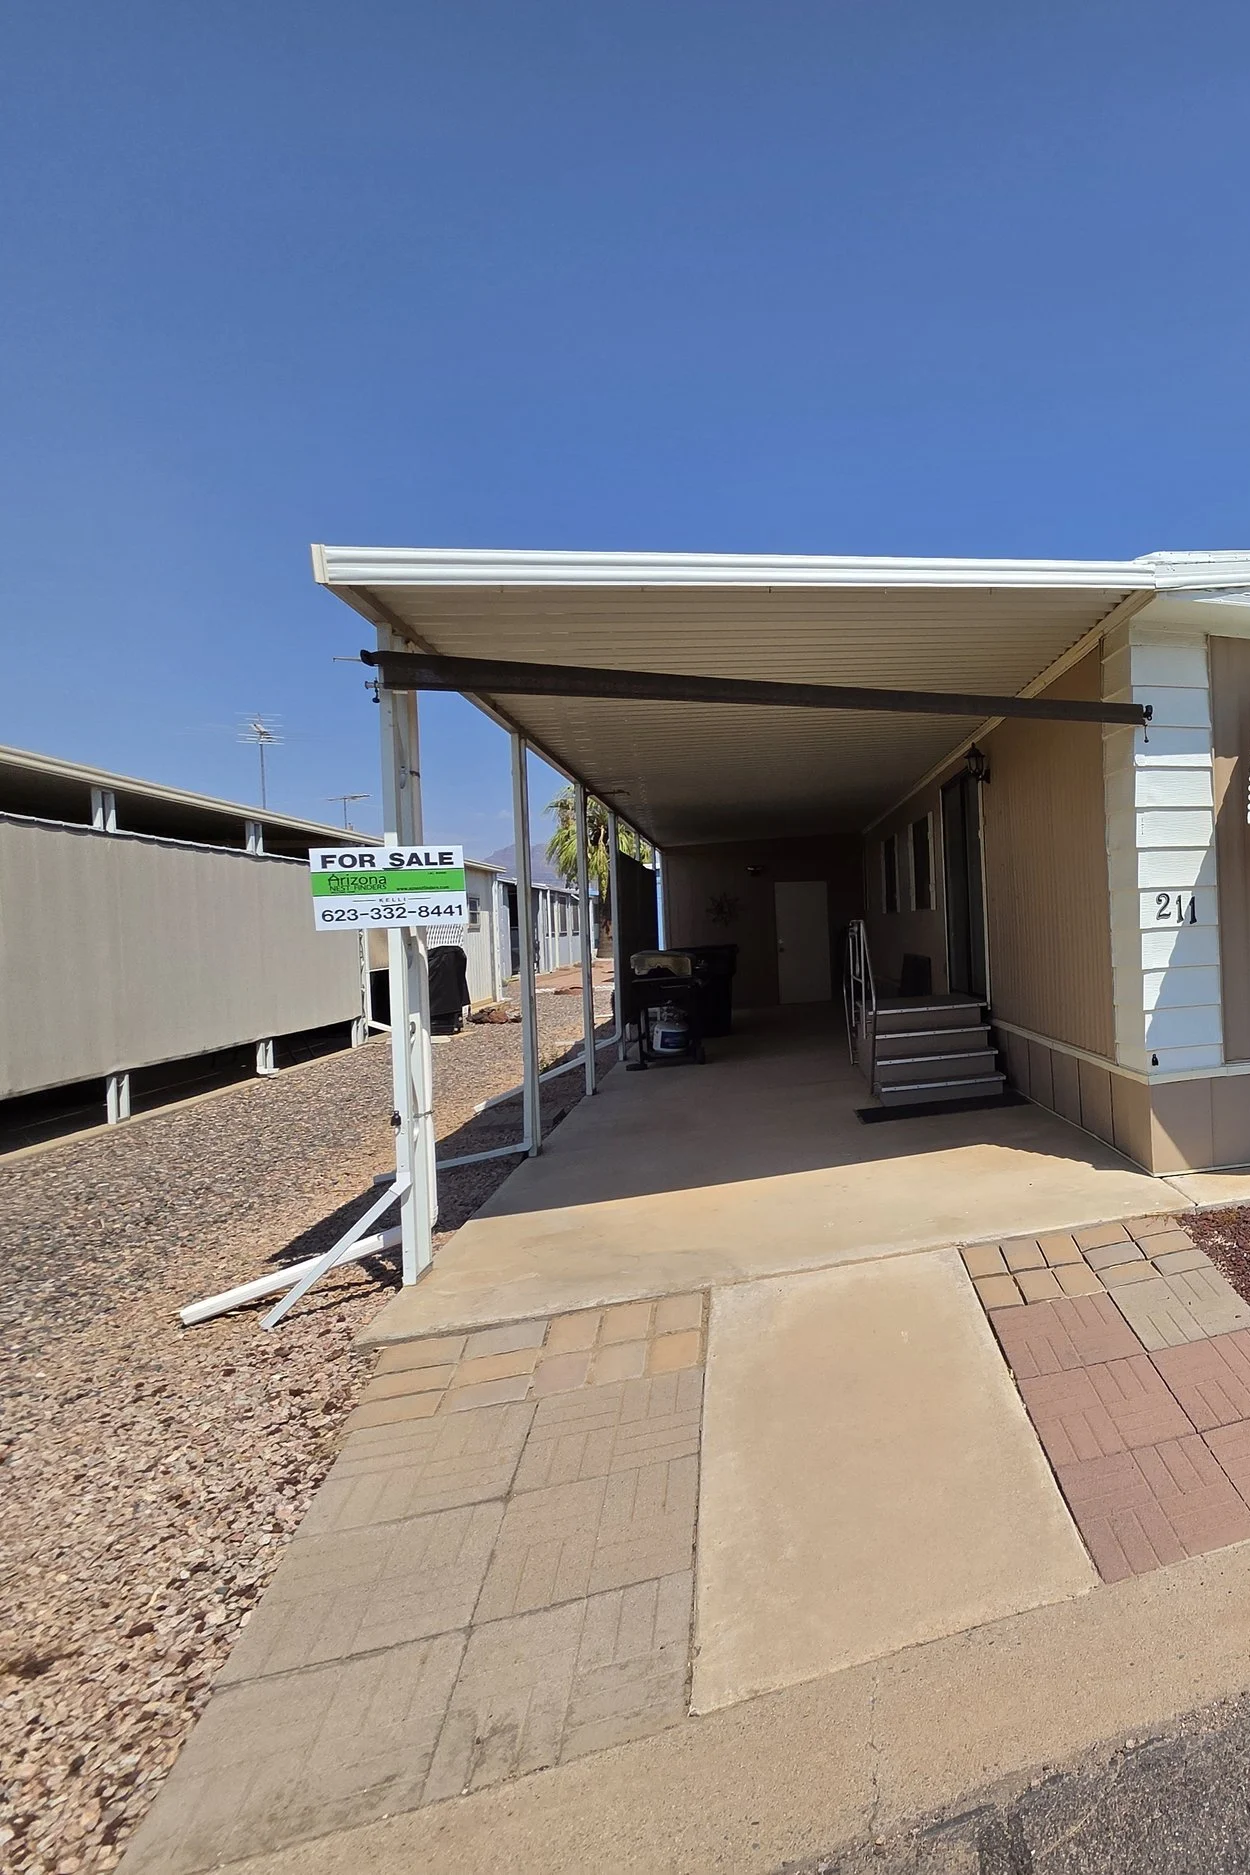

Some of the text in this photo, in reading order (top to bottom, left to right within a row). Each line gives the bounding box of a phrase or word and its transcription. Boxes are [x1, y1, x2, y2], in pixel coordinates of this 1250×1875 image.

[320, 851, 454, 869] FOR SALE
[327, 874, 387, 886] Arizona
[354, 883, 387, 891] FINDERS
[321, 904, 463, 923] 623-332-8441
[1155, 893, 1198, 925] 211
